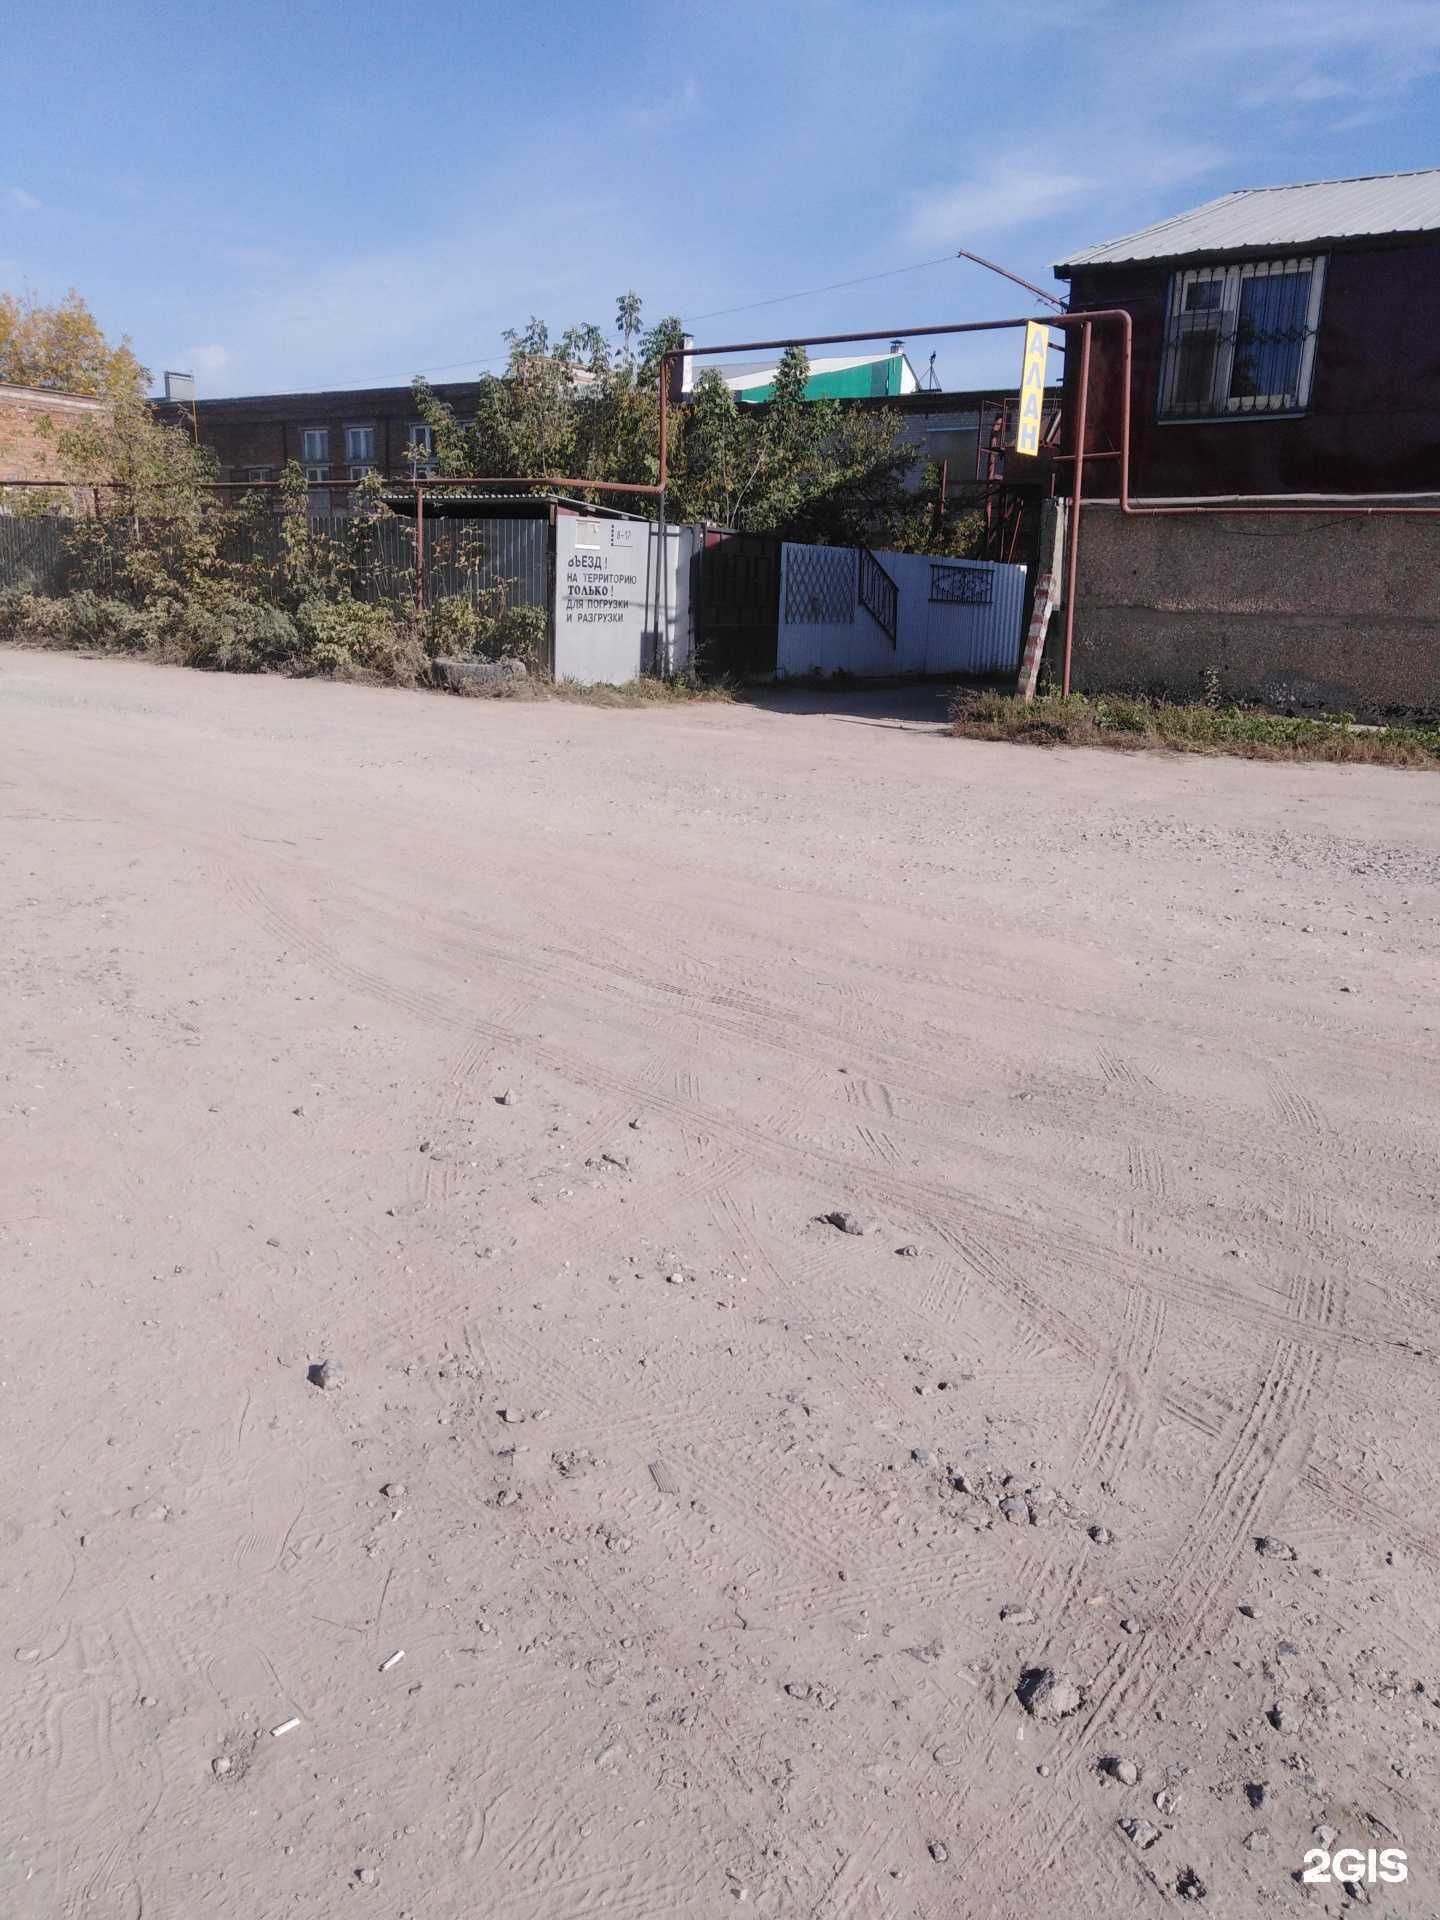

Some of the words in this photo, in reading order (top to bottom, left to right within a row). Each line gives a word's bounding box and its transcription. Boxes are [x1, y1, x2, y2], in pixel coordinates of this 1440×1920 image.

[1022, 329, 1045, 451] АЛАН
[567, 573, 578, 583] НА
[583, 573, 637, 584] ТЕРРИТОРИЮ
[566, 599, 584, 610] ДЛЯ
[587, 599, 629, 609] ПОГРУЗКИ
[566, 613, 573, 622] И
[577, 613, 624, 623] РАЗГРУЗКИ
